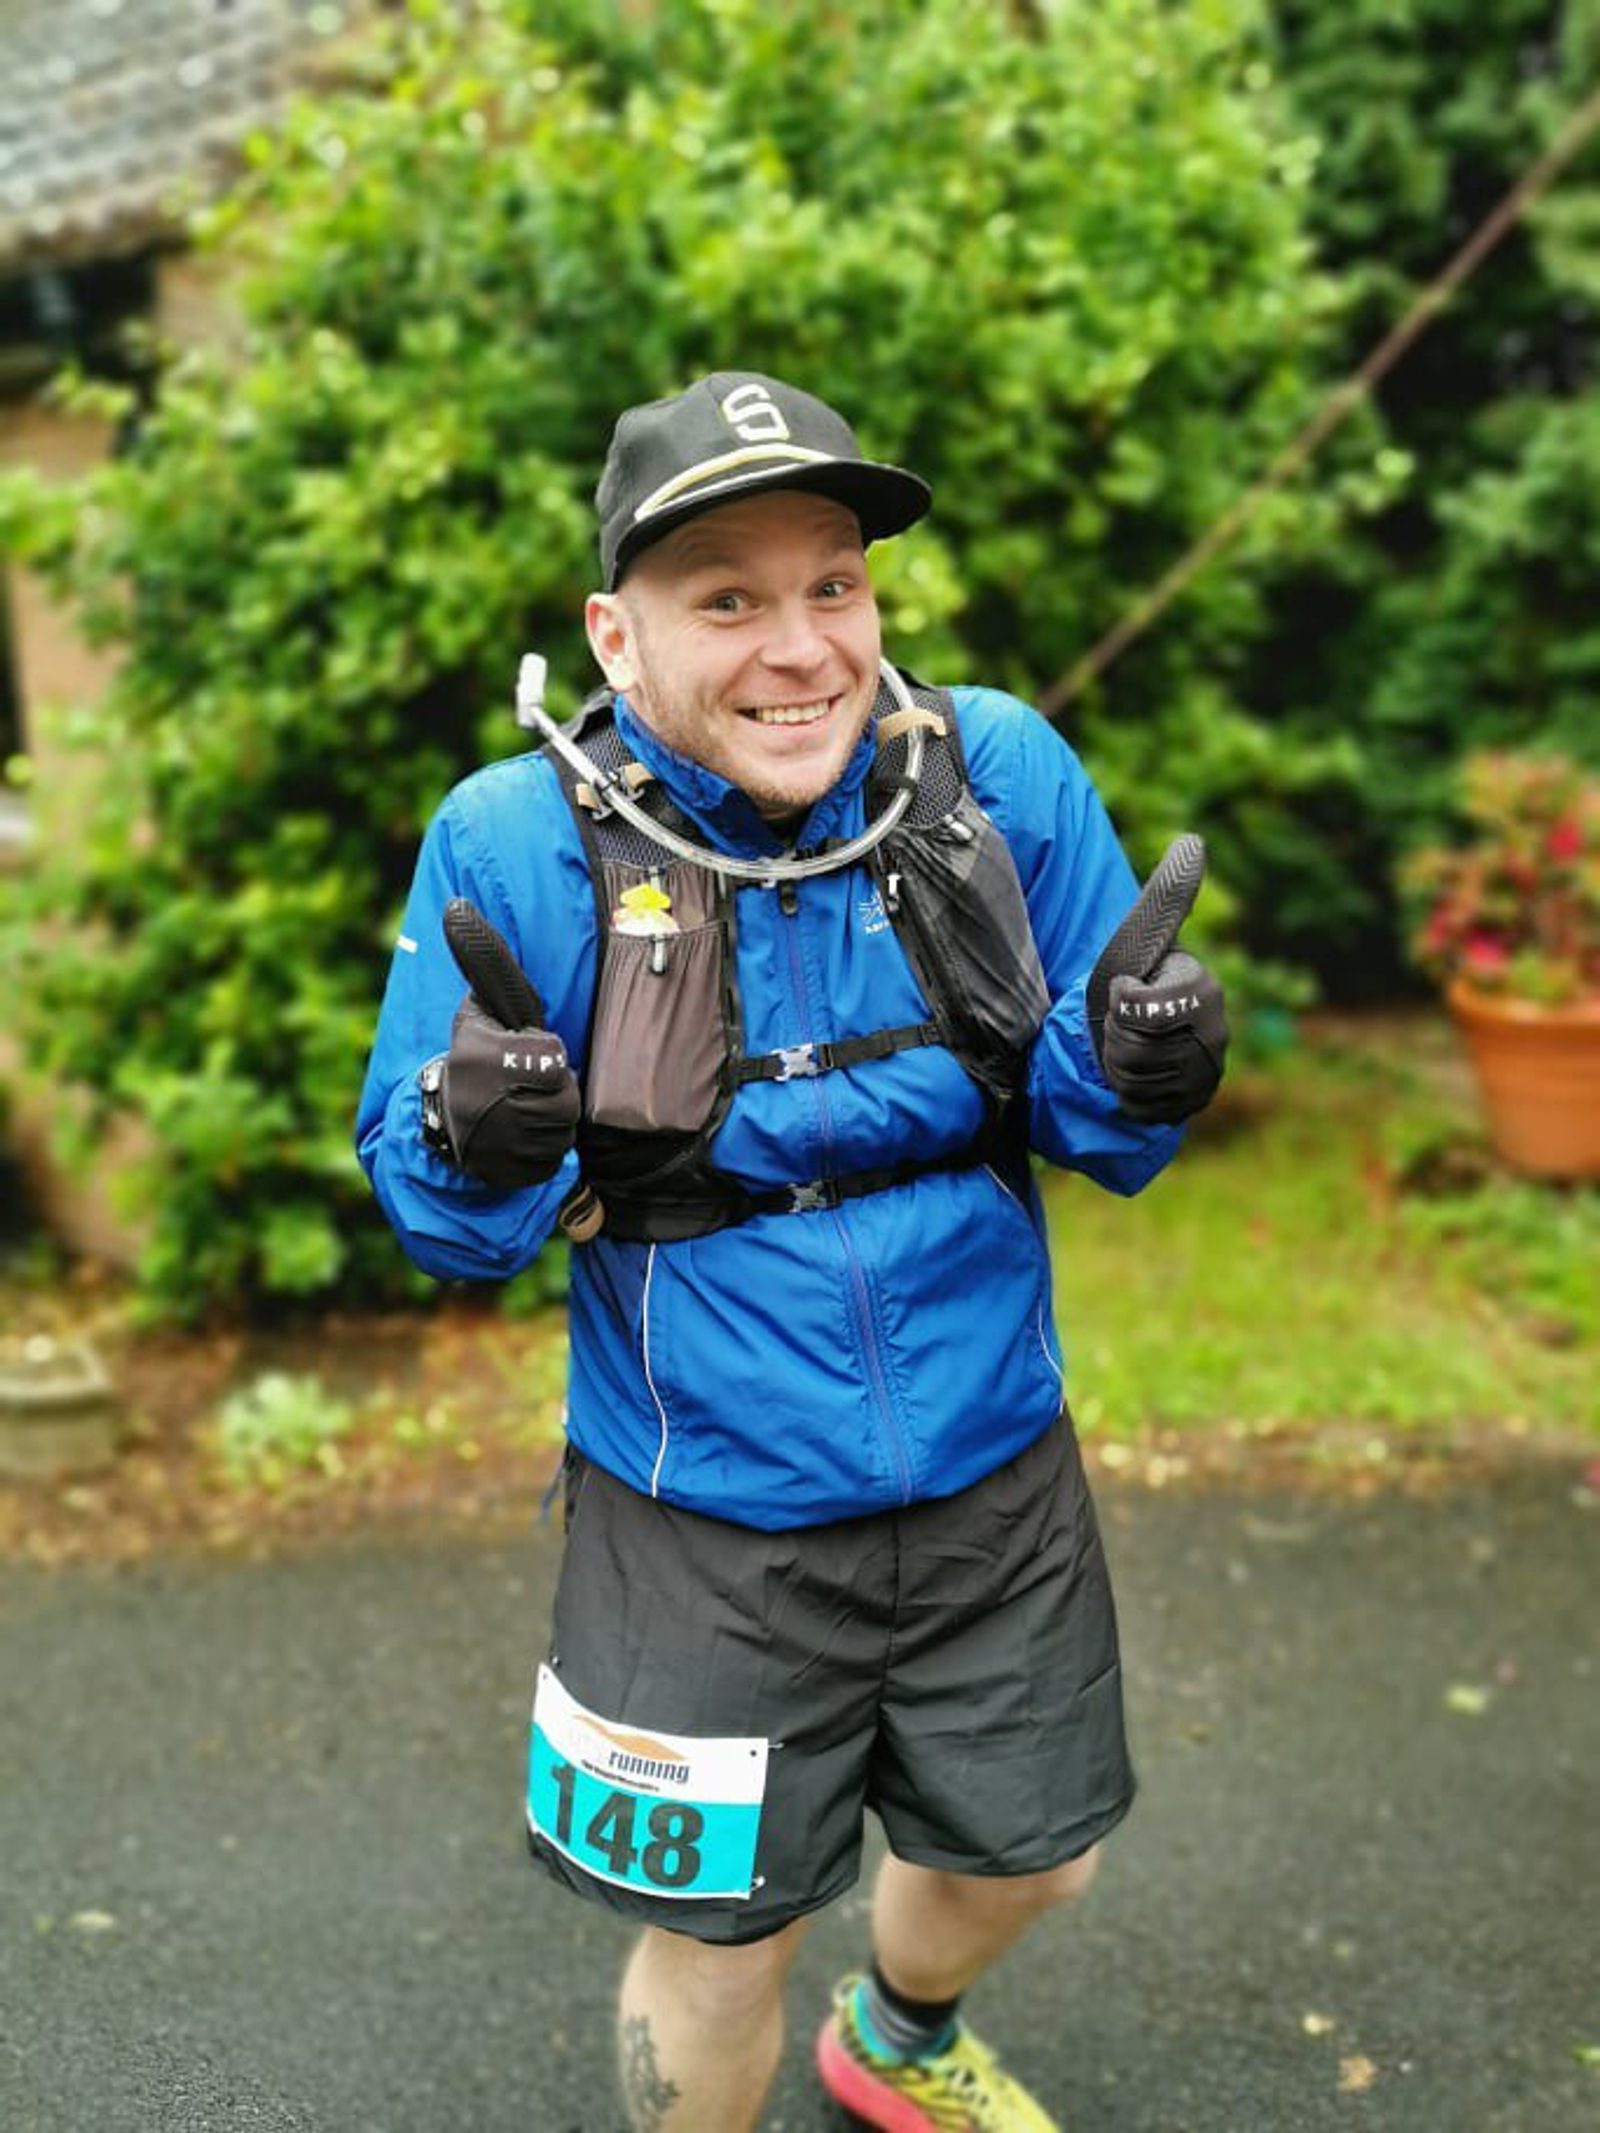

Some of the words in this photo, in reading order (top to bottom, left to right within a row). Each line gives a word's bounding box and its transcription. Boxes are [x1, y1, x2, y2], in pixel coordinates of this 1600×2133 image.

[721, 383, 790, 441] S
[1119, 994, 1200, 1019] KIPSTA
[608, 1749, 691, 1785] running
[551, 1762, 705, 1888] 148
